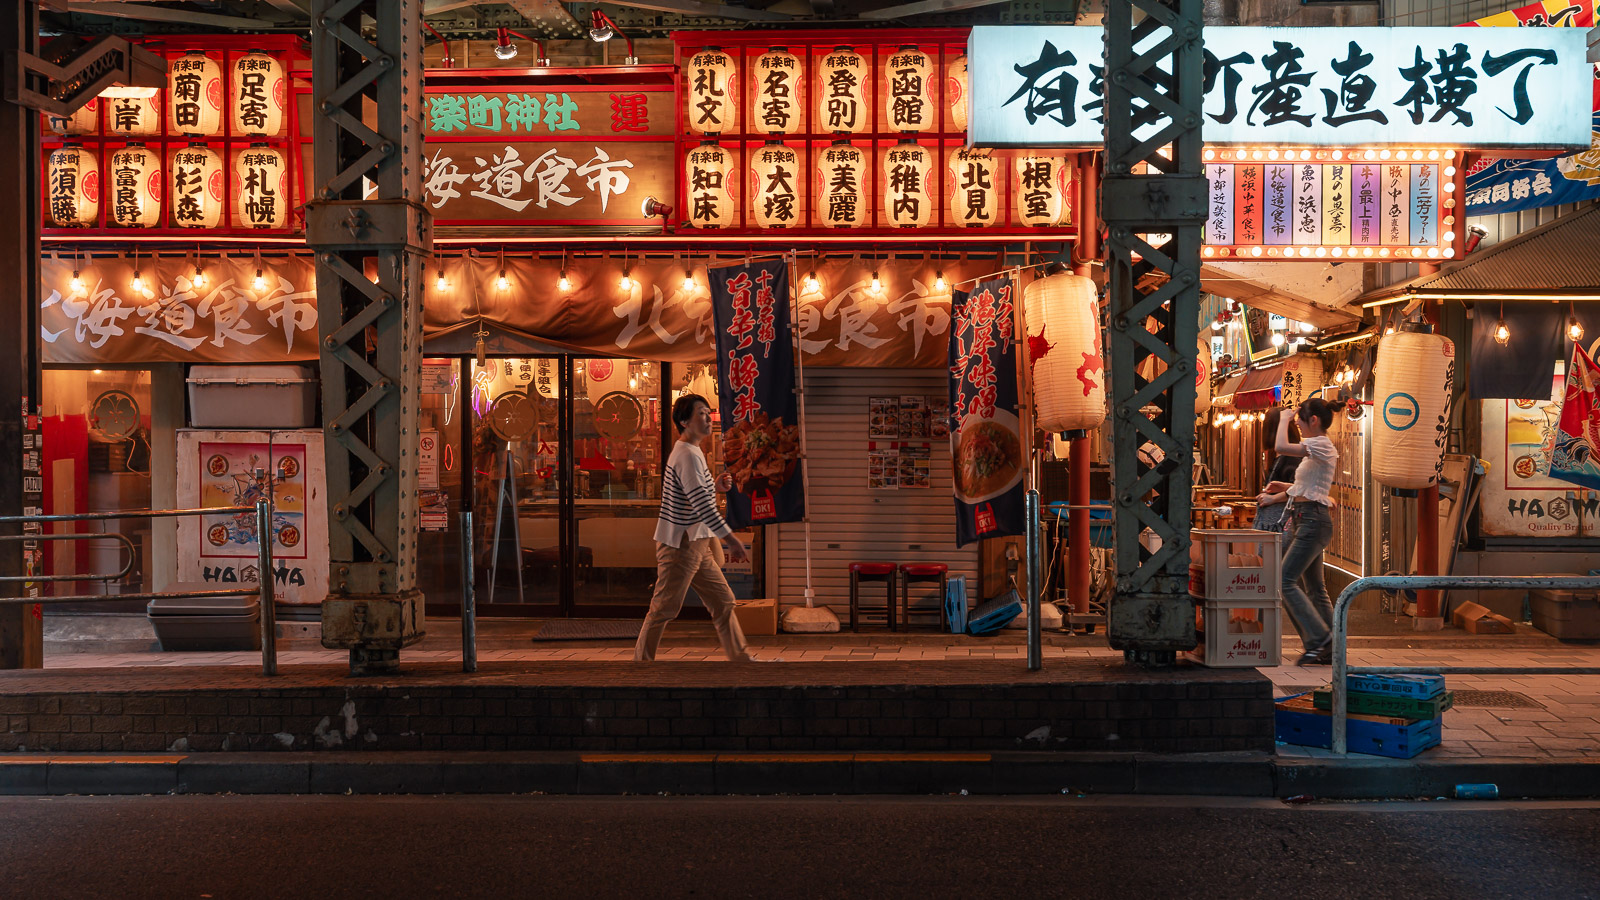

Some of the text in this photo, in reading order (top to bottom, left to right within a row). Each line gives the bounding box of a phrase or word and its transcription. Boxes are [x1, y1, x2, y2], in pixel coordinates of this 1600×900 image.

[173, 58, 206, 73] 有楽町
[237, 58, 272, 73] 有楽町
[693, 54, 727, 68] 有楽町
[760, 56, 796, 70] 有楽町
[825, 55, 860, 69] 有楽町
[889, 54, 925, 68] 有楽町
[174, 73, 202, 128] 菊田
[239, 72, 268, 129] 足寄
[694, 69, 725, 125] 礼文
[762, 70, 791, 128] 名寄
[827, 69, 858, 128] 登別
[891, 68, 924, 126] 函館
[1002, 39, 1558, 129] 有町産直横丁
[114, 97, 141, 131] 岸
[425, 93, 650, 132] 楽町神社 運
[50, 152, 80, 167] 有楽町
[113, 153, 146, 167] 有楽町
[174, 152, 208, 167] 有楽町
[243, 154, 278, 168] 有楽町
[690, 151, 724, 164] 有楽町
[761, 150, 795, 164] 有楽町
[825, 150, 860, 163] 有楽町
[888, 150, 924, 163] 有楽町
[51, 167, 77, 222] 須藤
[115, 166, 142, 222] 富良野
[175, 167, 203, 222] 杉森
[244, 168, 275, 223] 札幌
[692, 166, 723, 221] 知床
[763, 165, 795, 221] 大塚
[890, 164, 921, 221] 稚内
[961, 162, 992, 220] 北見
[1022, 162, 1053, 218] 根室
[1241, 166, 1256, 242] 横浜中華食市
[1270, 166, 1286, 238] 北海道食市
[1299, 164, 1317, 233] 魚の浜恵
[1416, 165, 1433, 243] 鳥の三芳ファーム
[1528, 523, 1562, 533] Quality
[1231, 573, 1260, 585] Asahi
[1257, 585, 1266, 593] 20
[1226, 650, 1235, 659] 大
[1258, 651, 1267, 659] 20
[1233, 639, 1261, 650] Asahi
